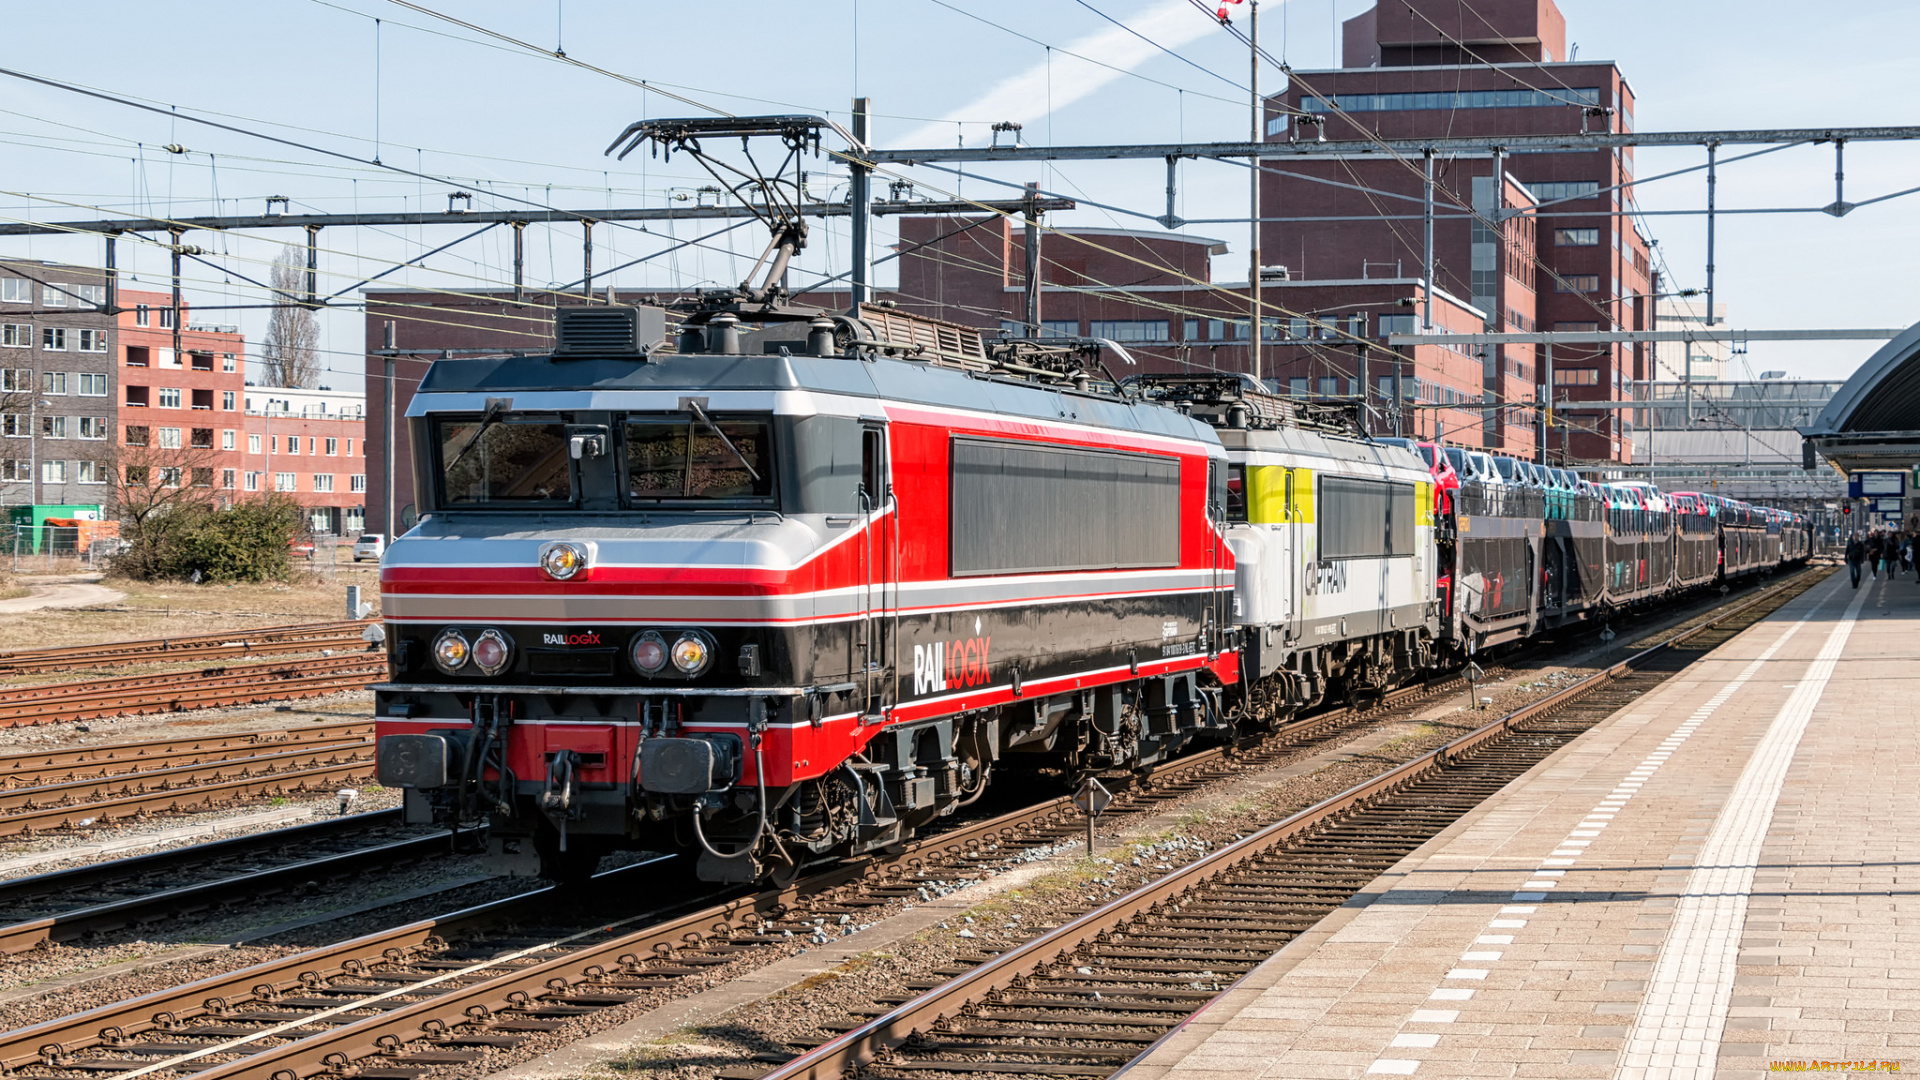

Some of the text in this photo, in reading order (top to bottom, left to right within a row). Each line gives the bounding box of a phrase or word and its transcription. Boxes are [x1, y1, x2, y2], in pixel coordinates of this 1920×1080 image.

[1305, 561, 1347, 596] CAPTRAIN
[543, 630, 601, 645] RAILLOGIX
[914, 617, 991, 696] RAILLOGIX
